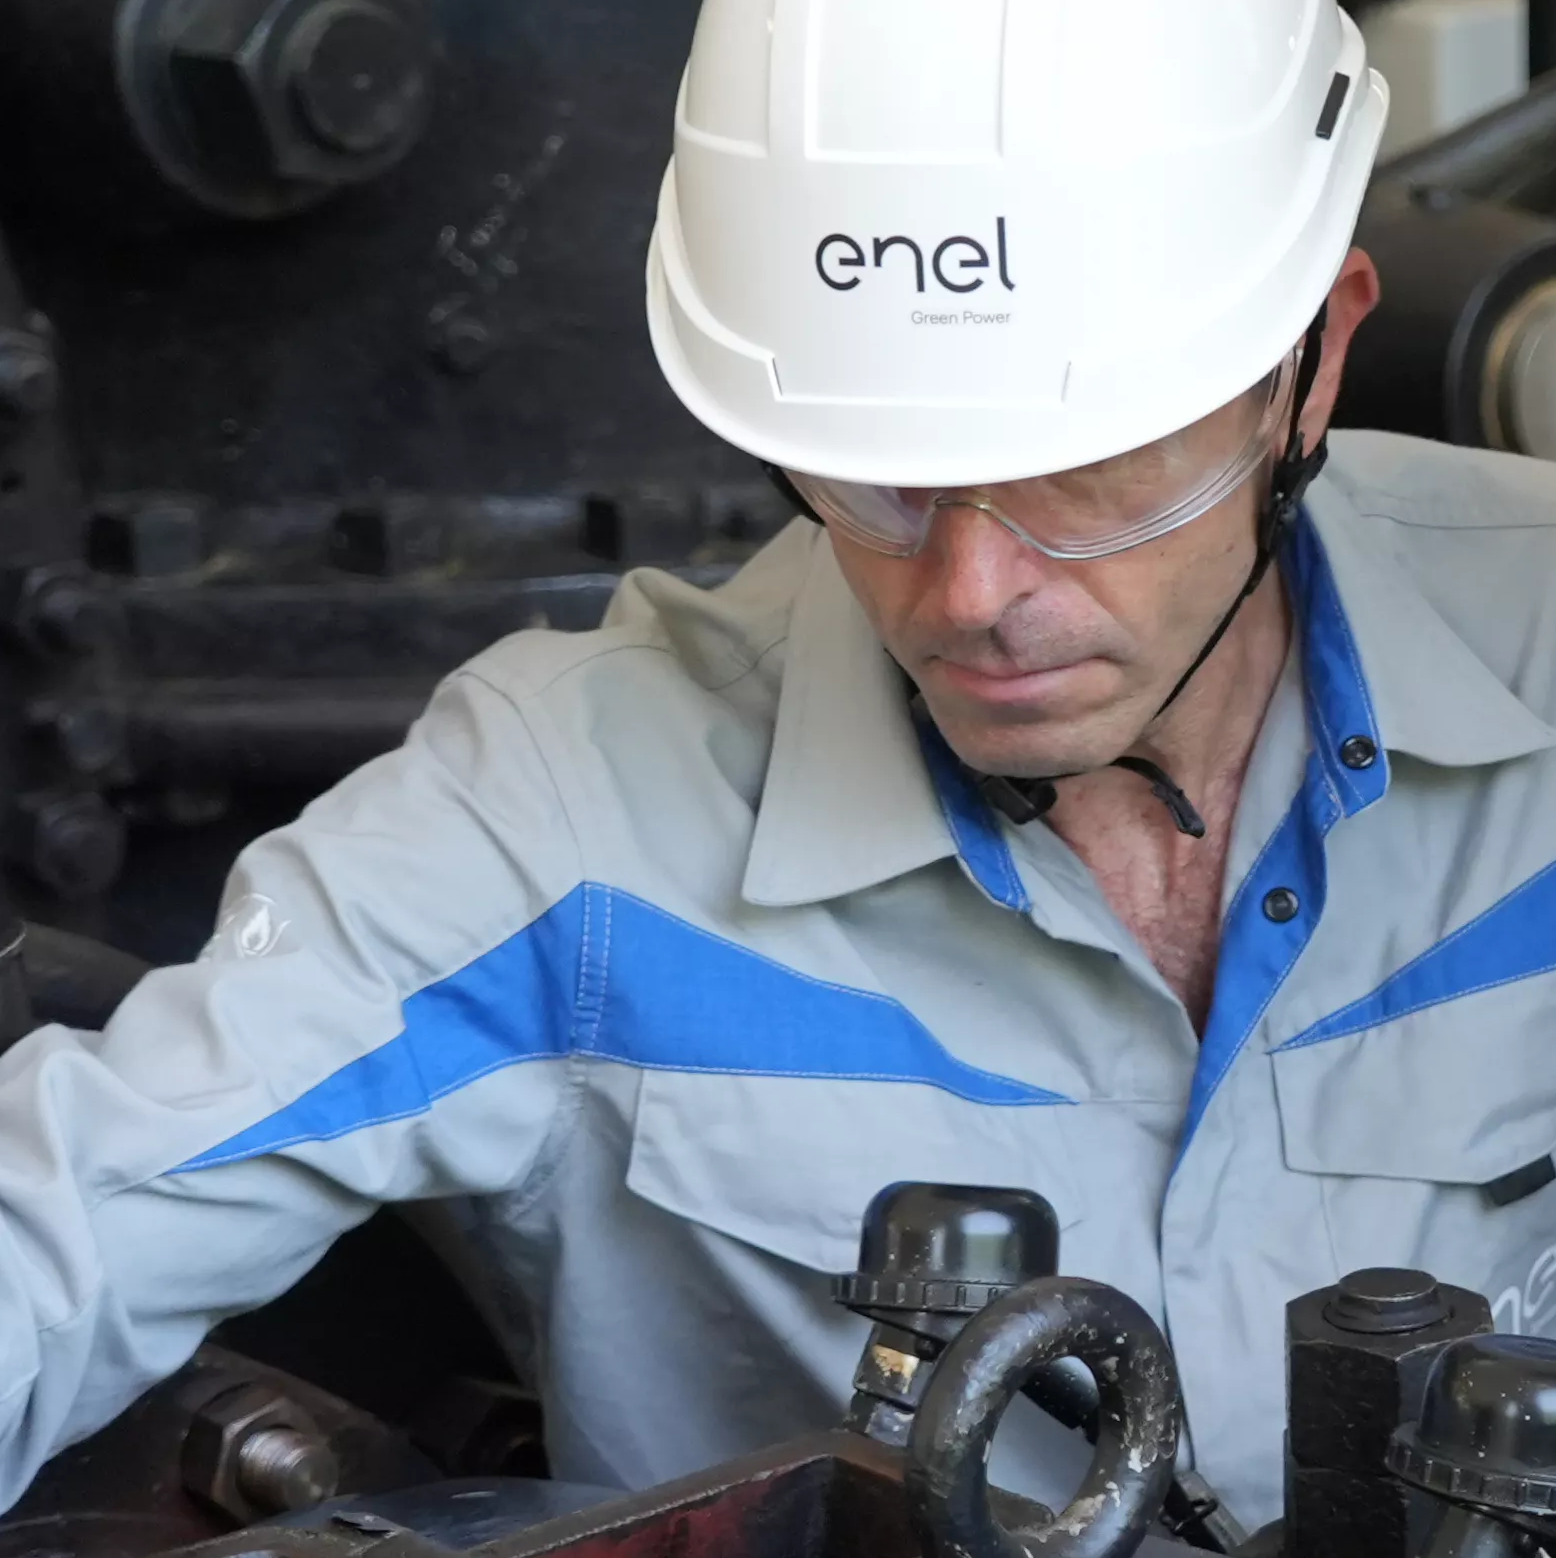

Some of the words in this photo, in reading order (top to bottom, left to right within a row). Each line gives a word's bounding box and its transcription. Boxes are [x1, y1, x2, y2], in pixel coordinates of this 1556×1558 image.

[815, 216, 1016, 294] enel
[911, 309, 959, 325] Green
[962, 309, 1011, 325] Power
